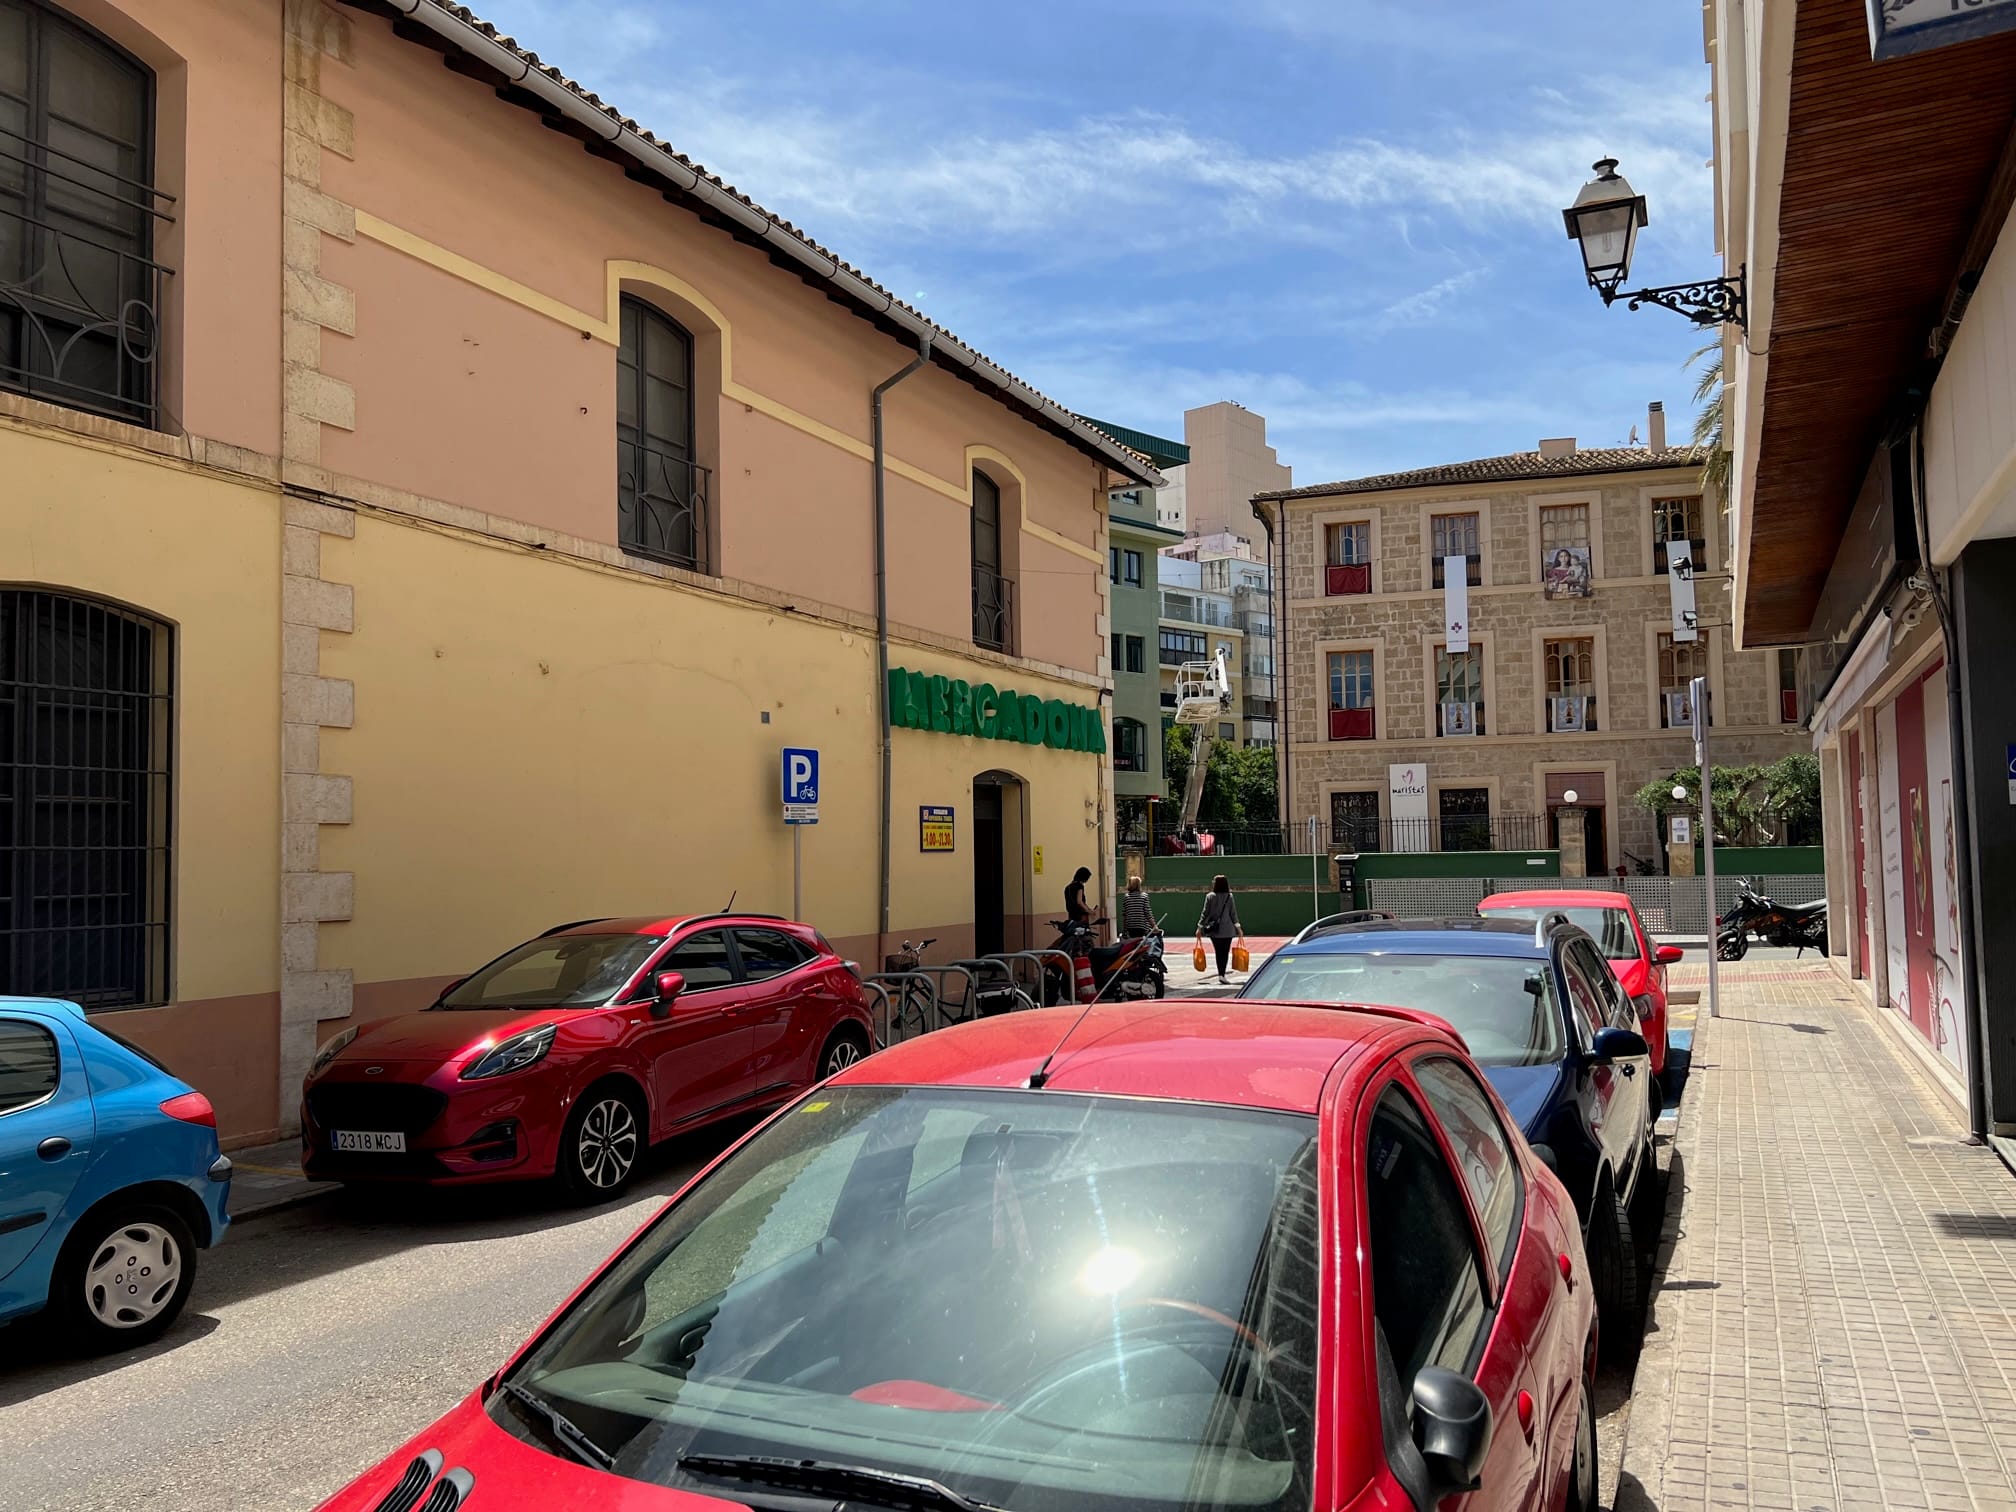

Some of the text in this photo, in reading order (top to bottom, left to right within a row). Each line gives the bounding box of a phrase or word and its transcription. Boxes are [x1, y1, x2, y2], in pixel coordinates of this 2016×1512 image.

[888, 667, 1107, 754] MERCADONA
[790, 754, 812, 797] P
[340, 1132, 401, 1150] 2318 MCJ
